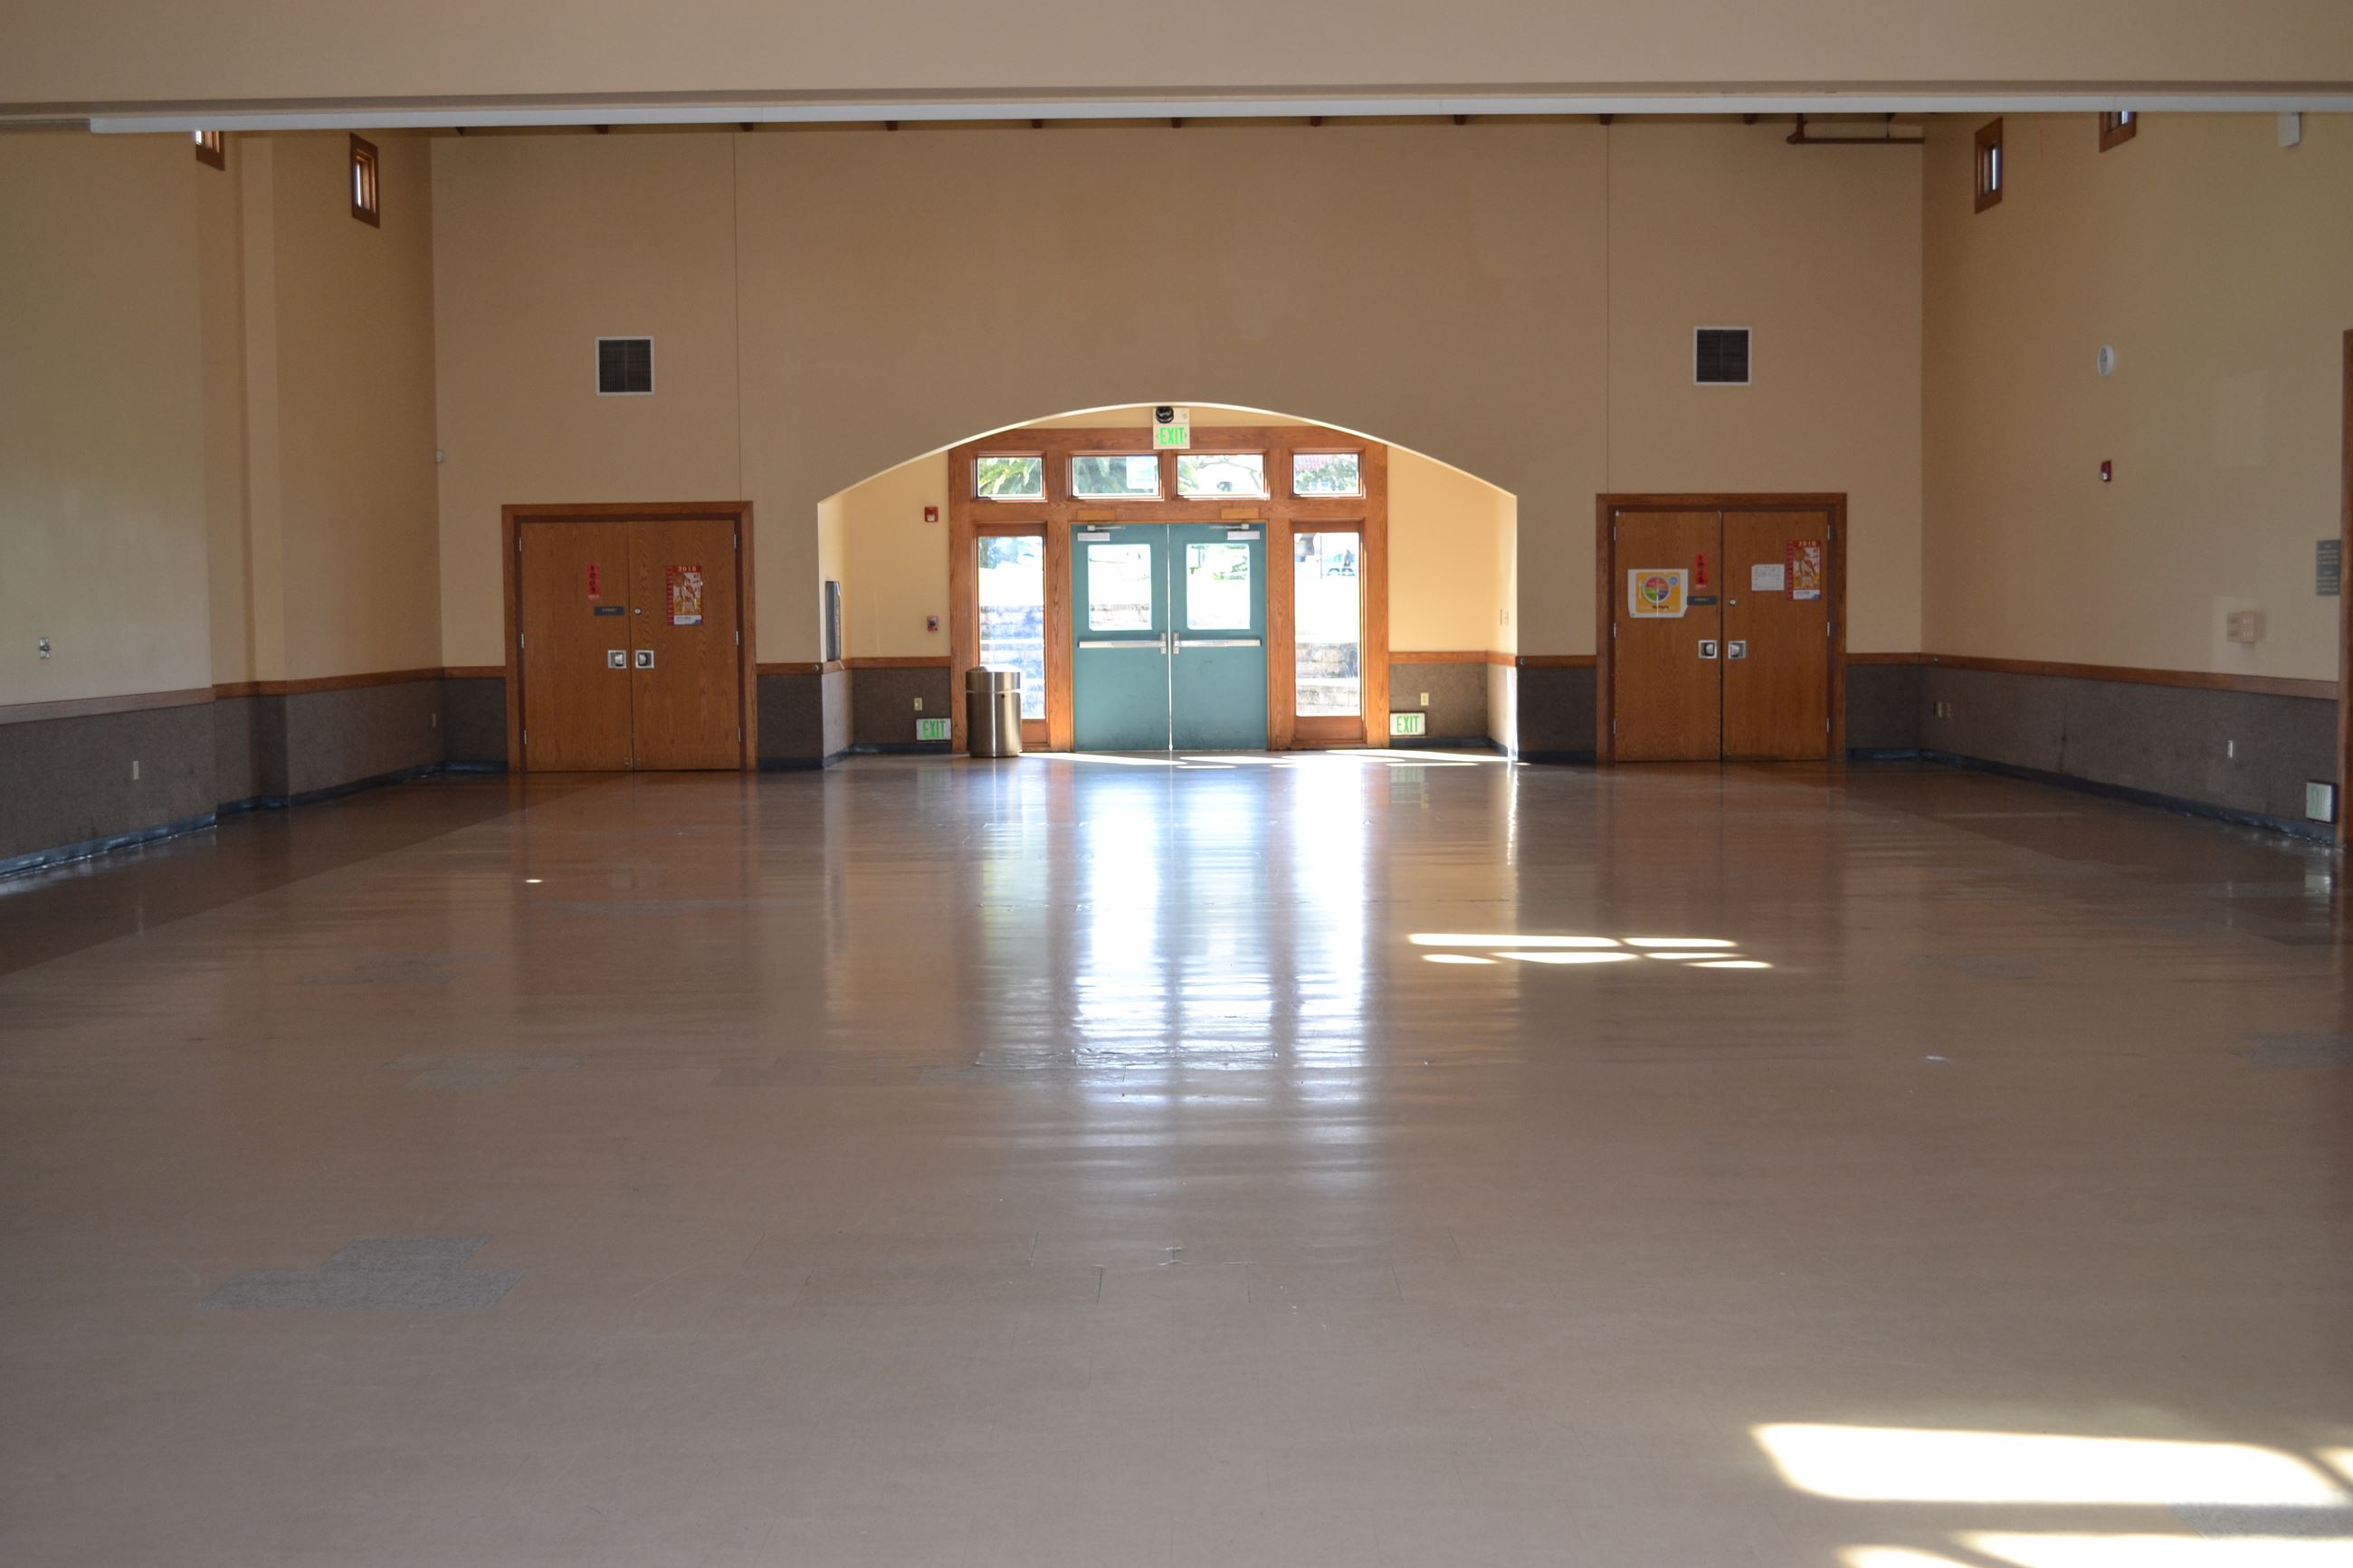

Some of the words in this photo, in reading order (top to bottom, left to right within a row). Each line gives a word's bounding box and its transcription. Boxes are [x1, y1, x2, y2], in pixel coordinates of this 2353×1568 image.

[1159, 427, 1185, 445] EXIT
[923, 720, 946, 738] EXIT
[1396, 716, 1419, 733] EXIT
